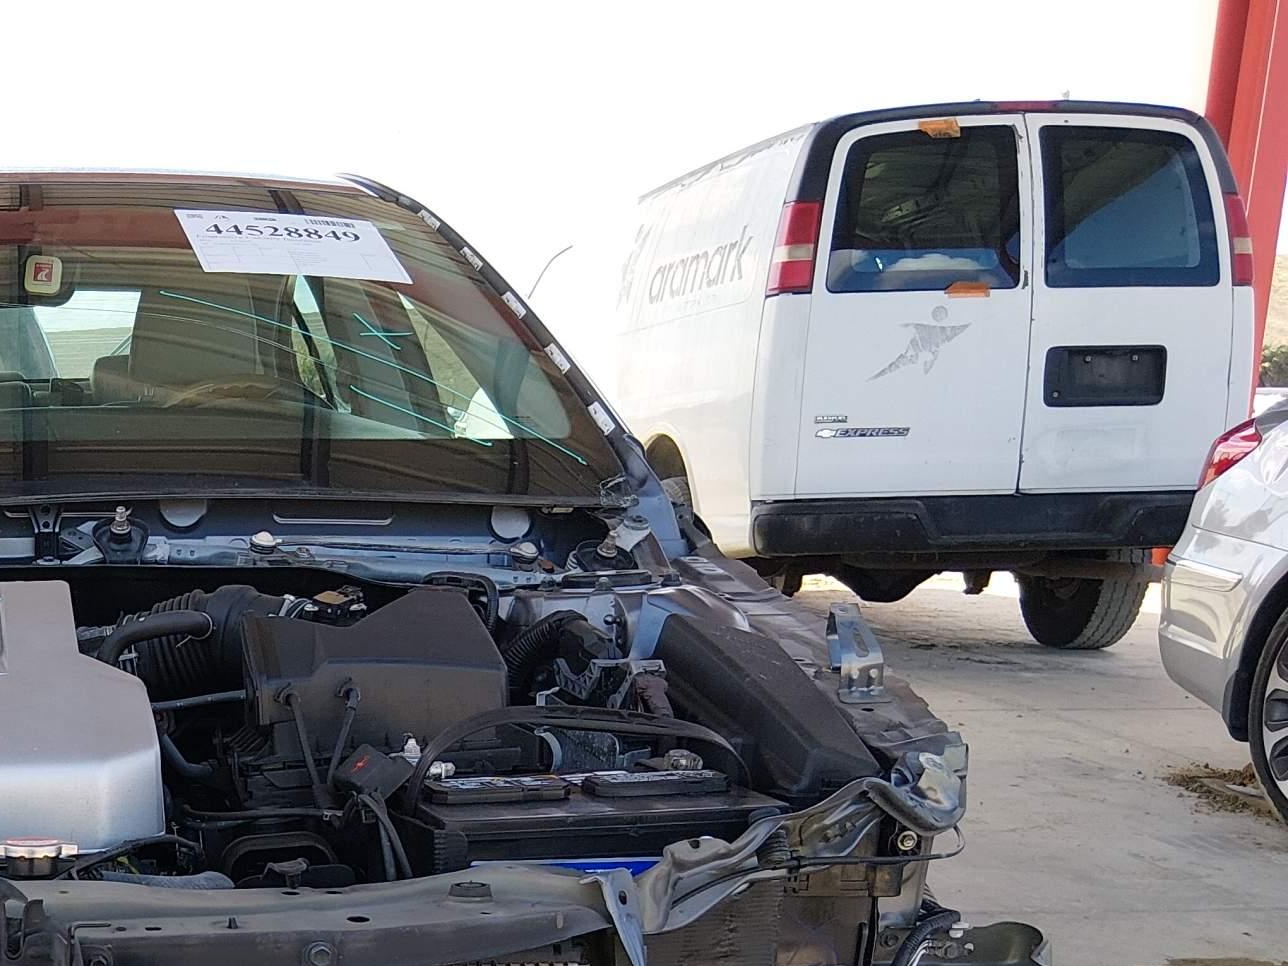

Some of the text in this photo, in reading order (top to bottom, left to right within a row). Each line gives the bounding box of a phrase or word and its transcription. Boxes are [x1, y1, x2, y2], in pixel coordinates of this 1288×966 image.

[205, 222, 361, 243] 44528849
[649, 223, 755, 305] aramark
[834, 427, 910, 438] EXPRESS
